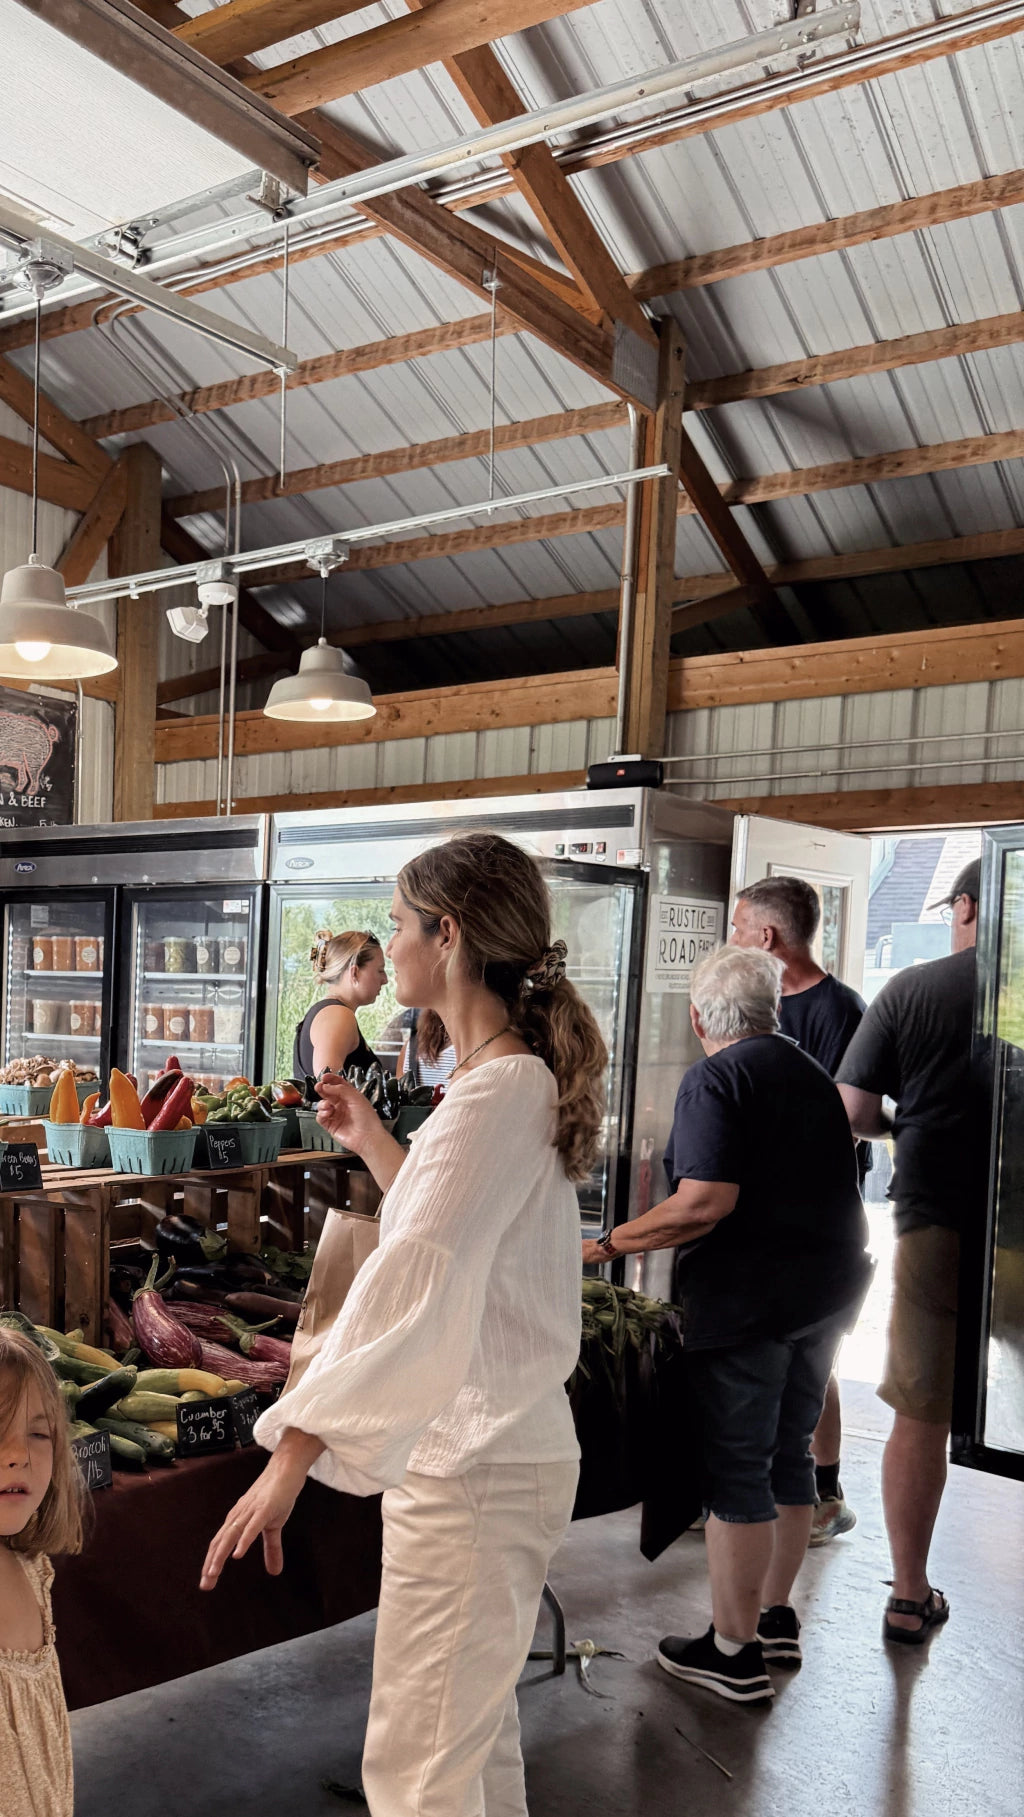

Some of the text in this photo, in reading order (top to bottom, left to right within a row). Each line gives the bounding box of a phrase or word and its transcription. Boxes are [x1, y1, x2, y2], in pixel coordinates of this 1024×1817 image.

[8, 791, 18, 806] &
[21, 795, 46, 808] BEEF
[669, 907, 706, 930] RUSTIC
[659, 938, 696, 964] ROAD
[209, 1134, 236, 1151] Peppers
[187, 1419, 225, 1443] 3 for $5
